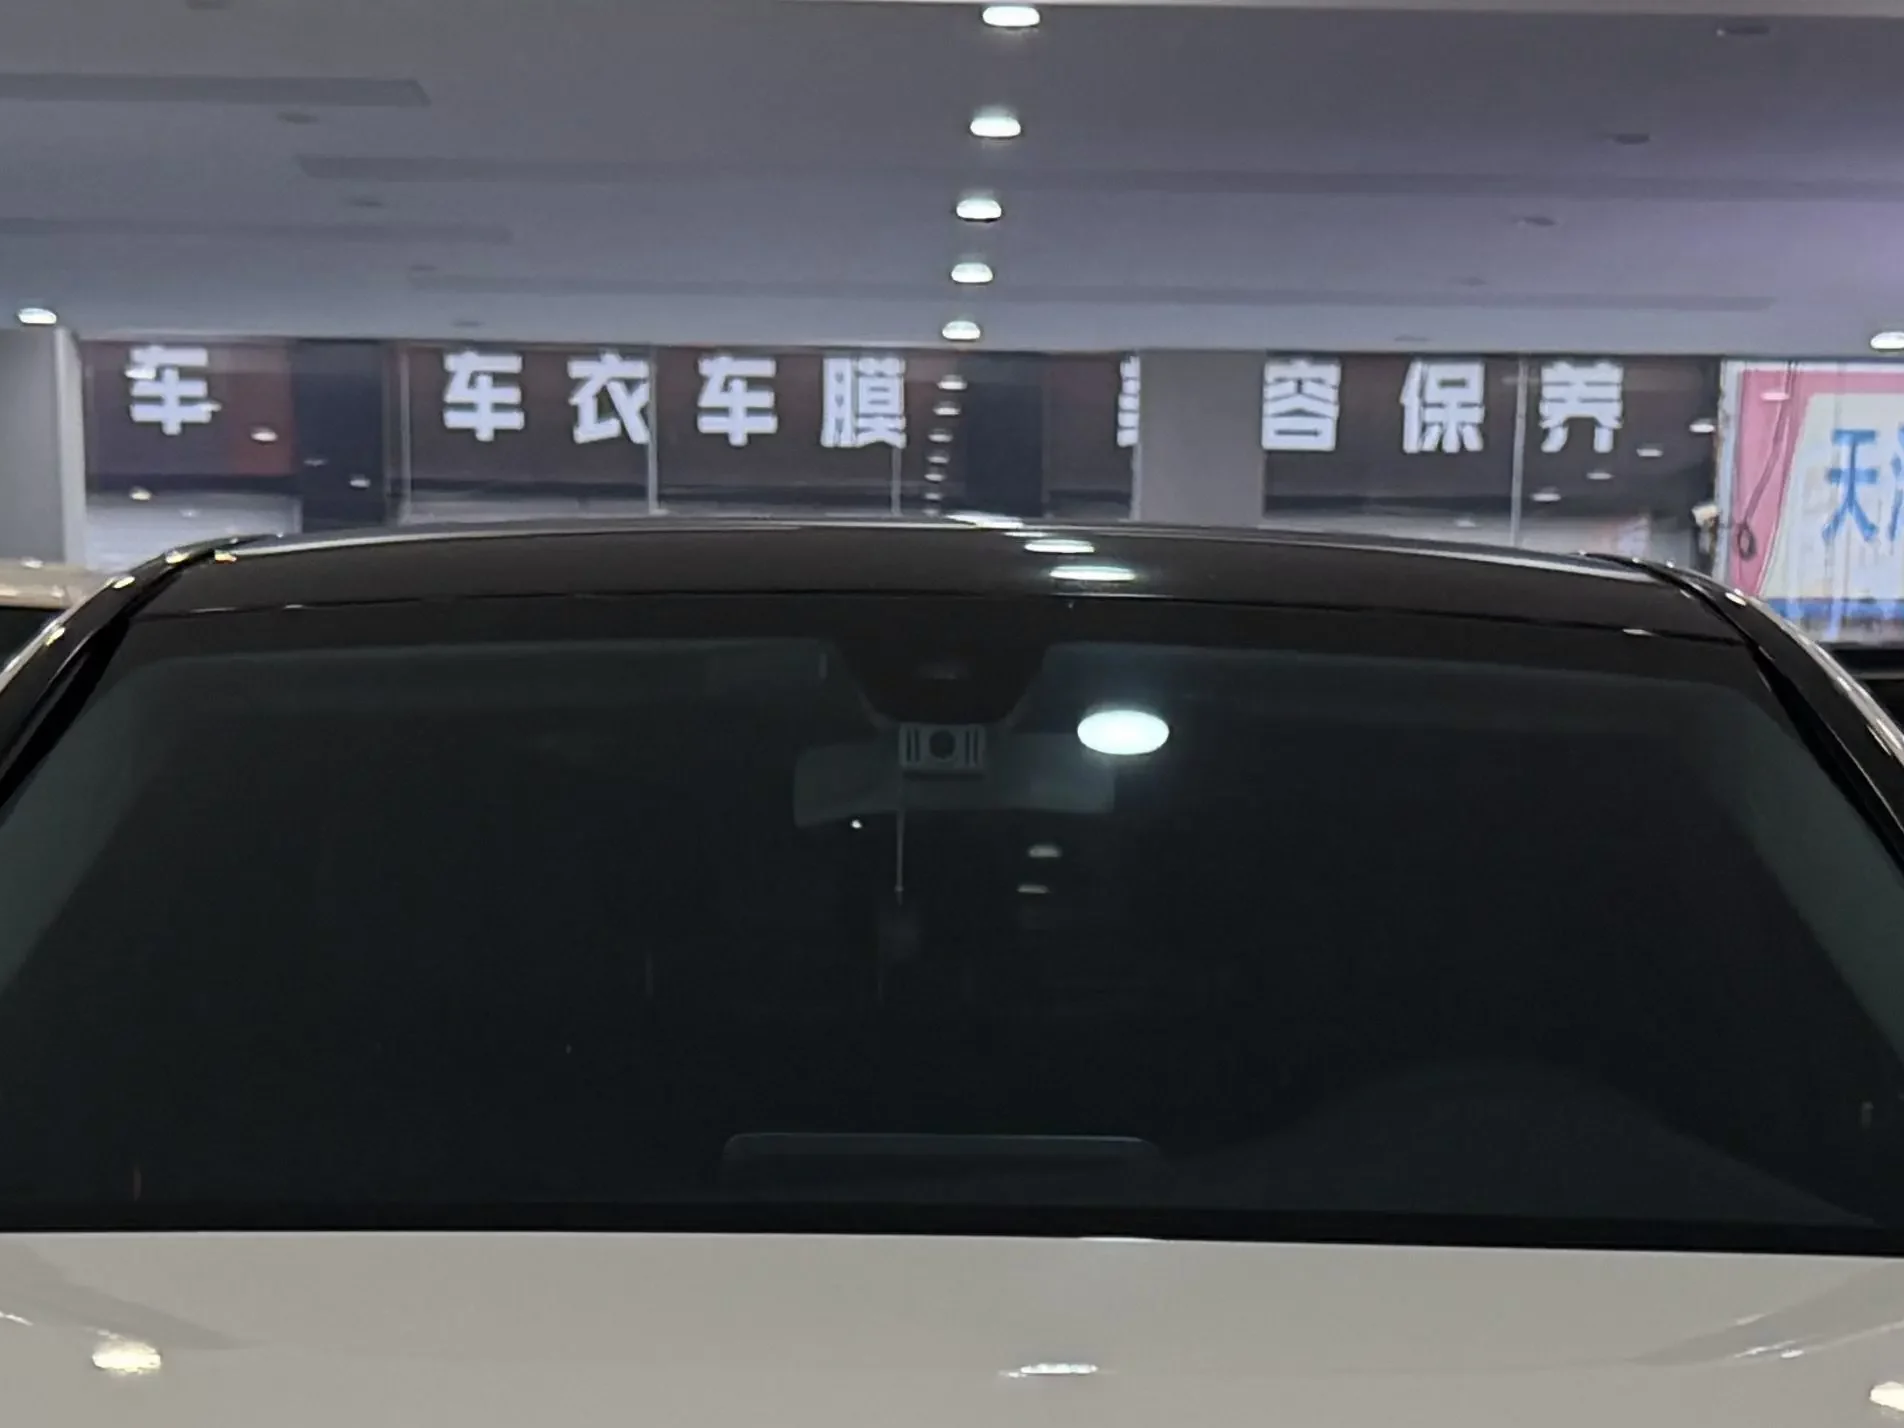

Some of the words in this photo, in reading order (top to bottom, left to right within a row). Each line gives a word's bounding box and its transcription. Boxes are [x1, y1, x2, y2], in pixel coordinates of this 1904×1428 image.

[444, 351, 907, 449] 车衣车膜
[1117, 354, 1624, 453] 容保养
